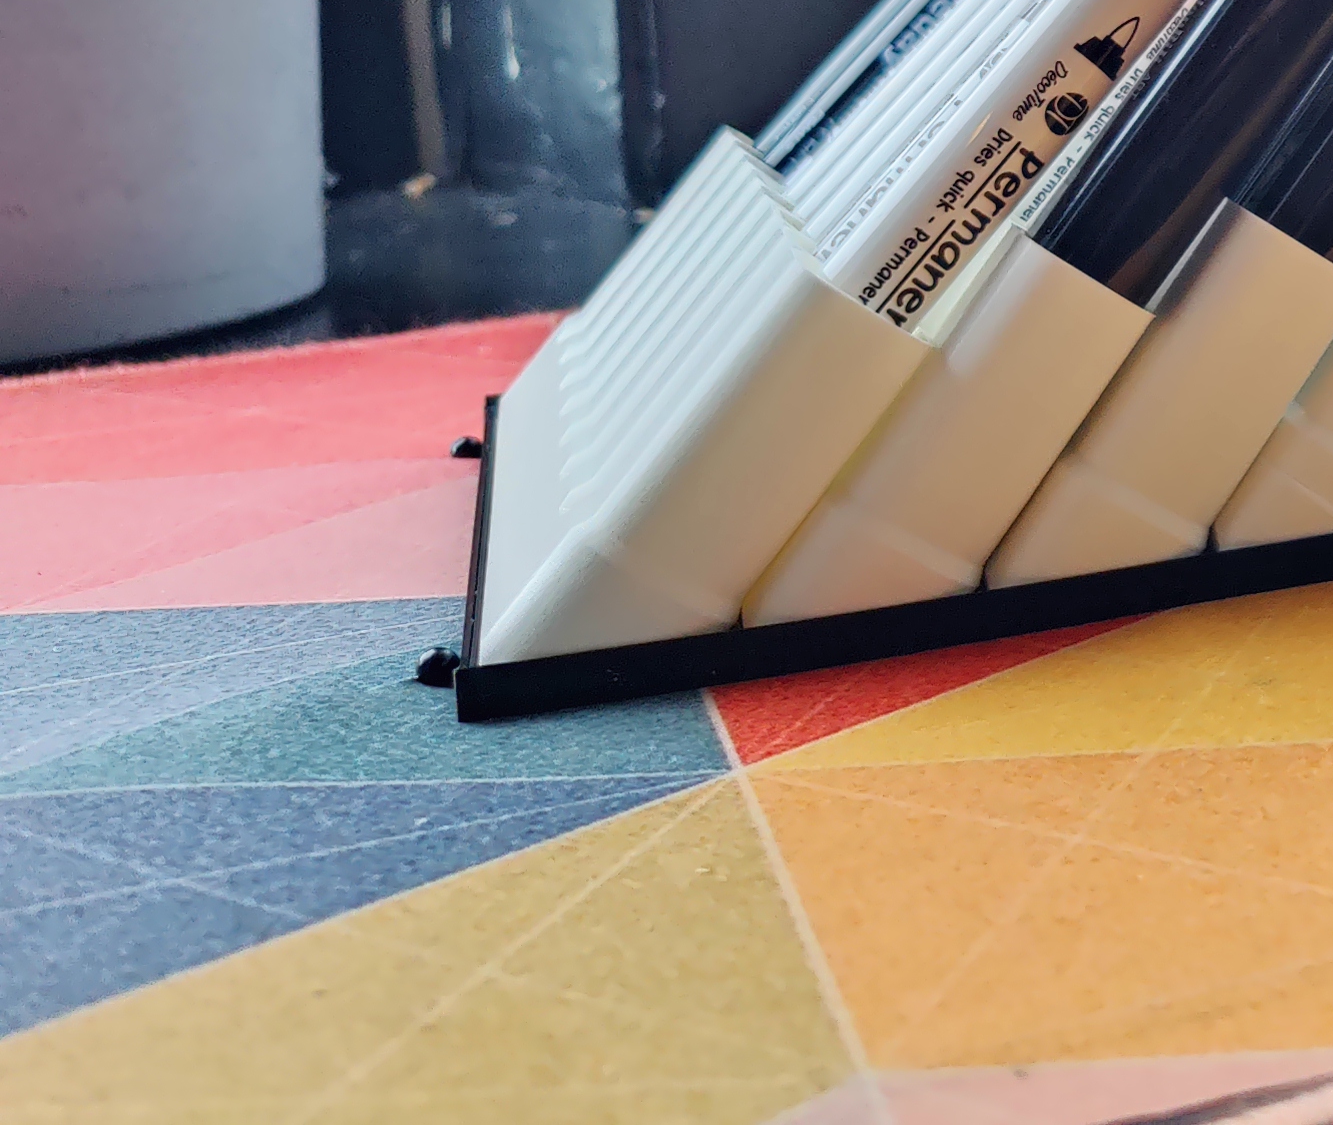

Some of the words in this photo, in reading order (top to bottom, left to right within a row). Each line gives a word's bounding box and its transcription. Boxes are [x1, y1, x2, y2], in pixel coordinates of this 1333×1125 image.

[1079, 101, 1117, 144] quick
[970, 125, 1013, 171] Dries
[932, 165, 978, 216] quick
